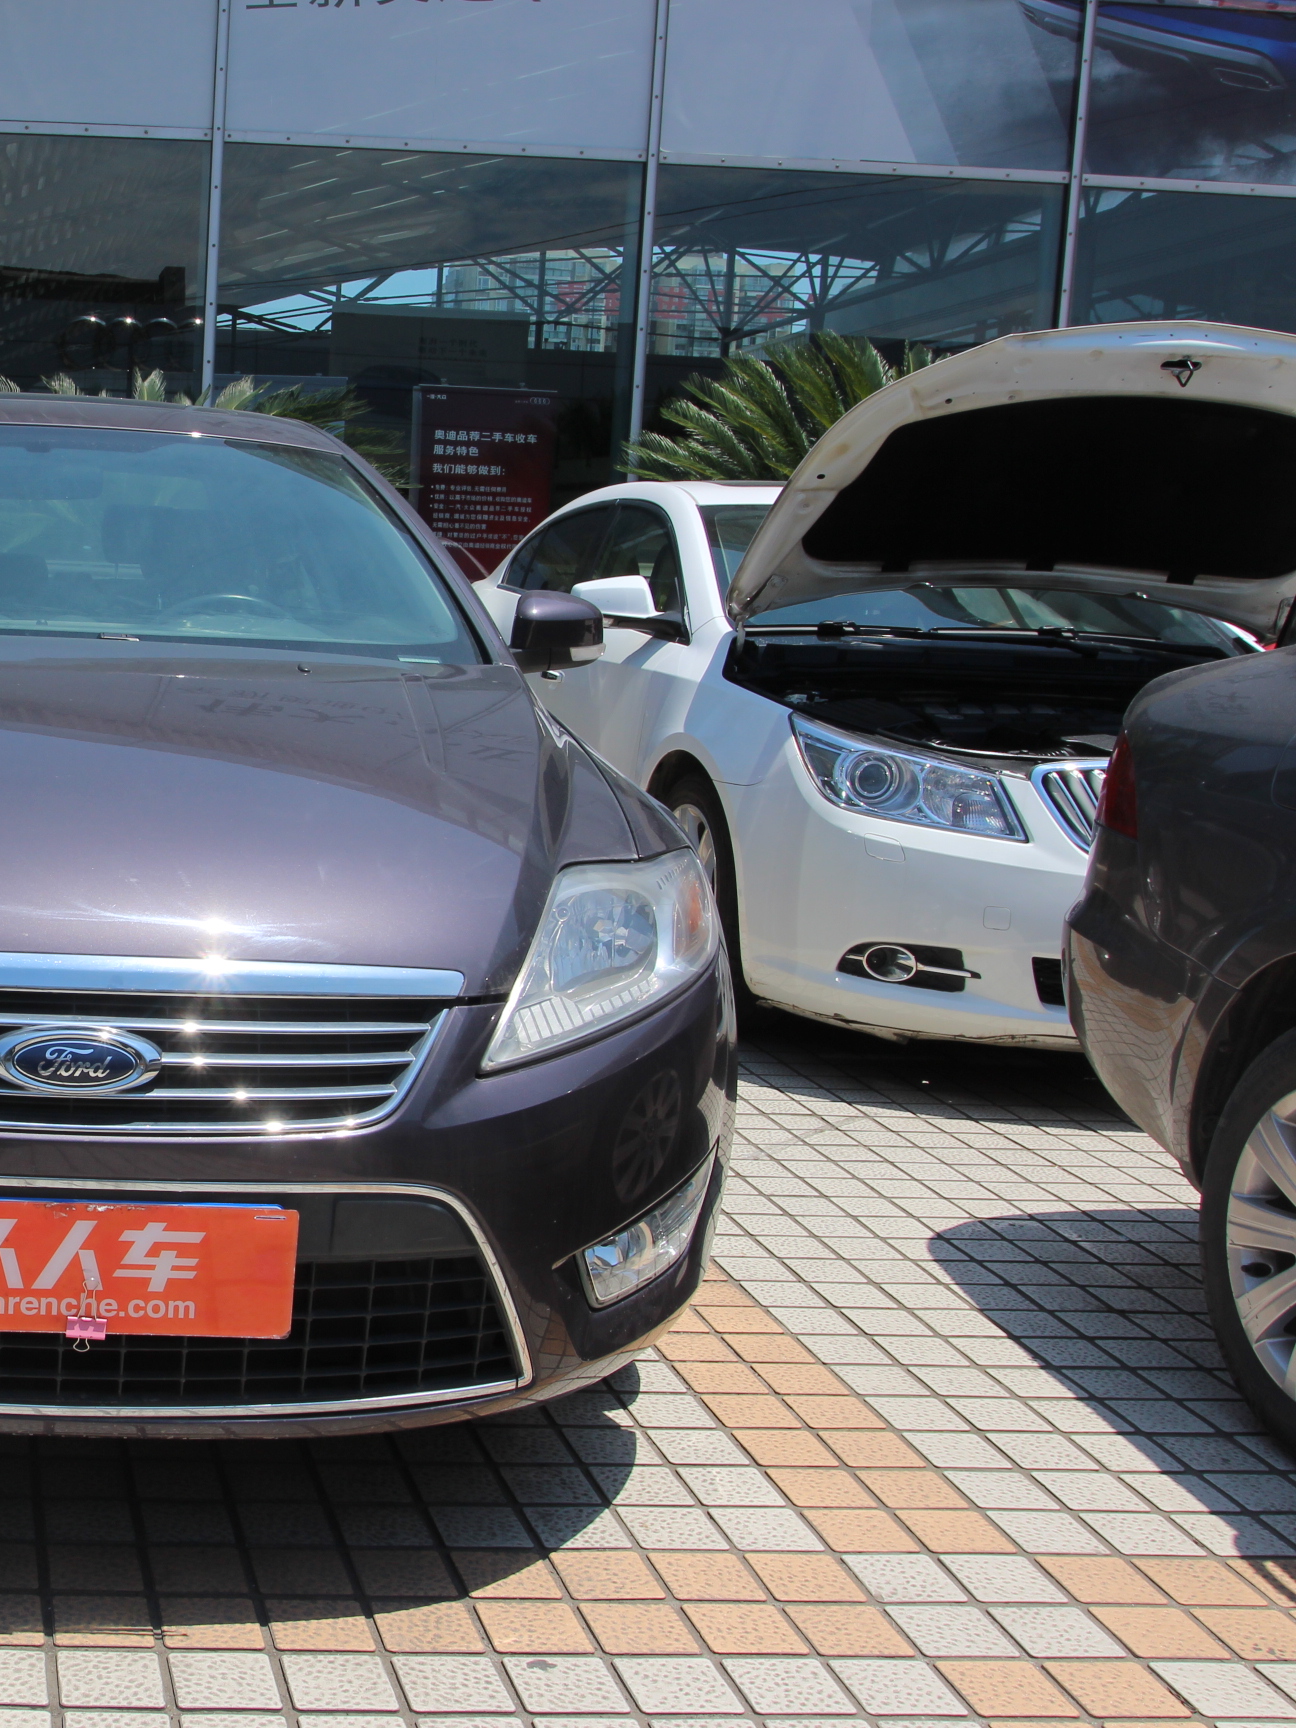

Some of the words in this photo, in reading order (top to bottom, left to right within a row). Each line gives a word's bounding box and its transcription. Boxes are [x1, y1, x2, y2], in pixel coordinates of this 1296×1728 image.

[434, 429, 538, 444] 奥迪品荐二手车收车
[433, 444, 479, 457] 服务特色
[37, 1046, 111, 1078] Ford
